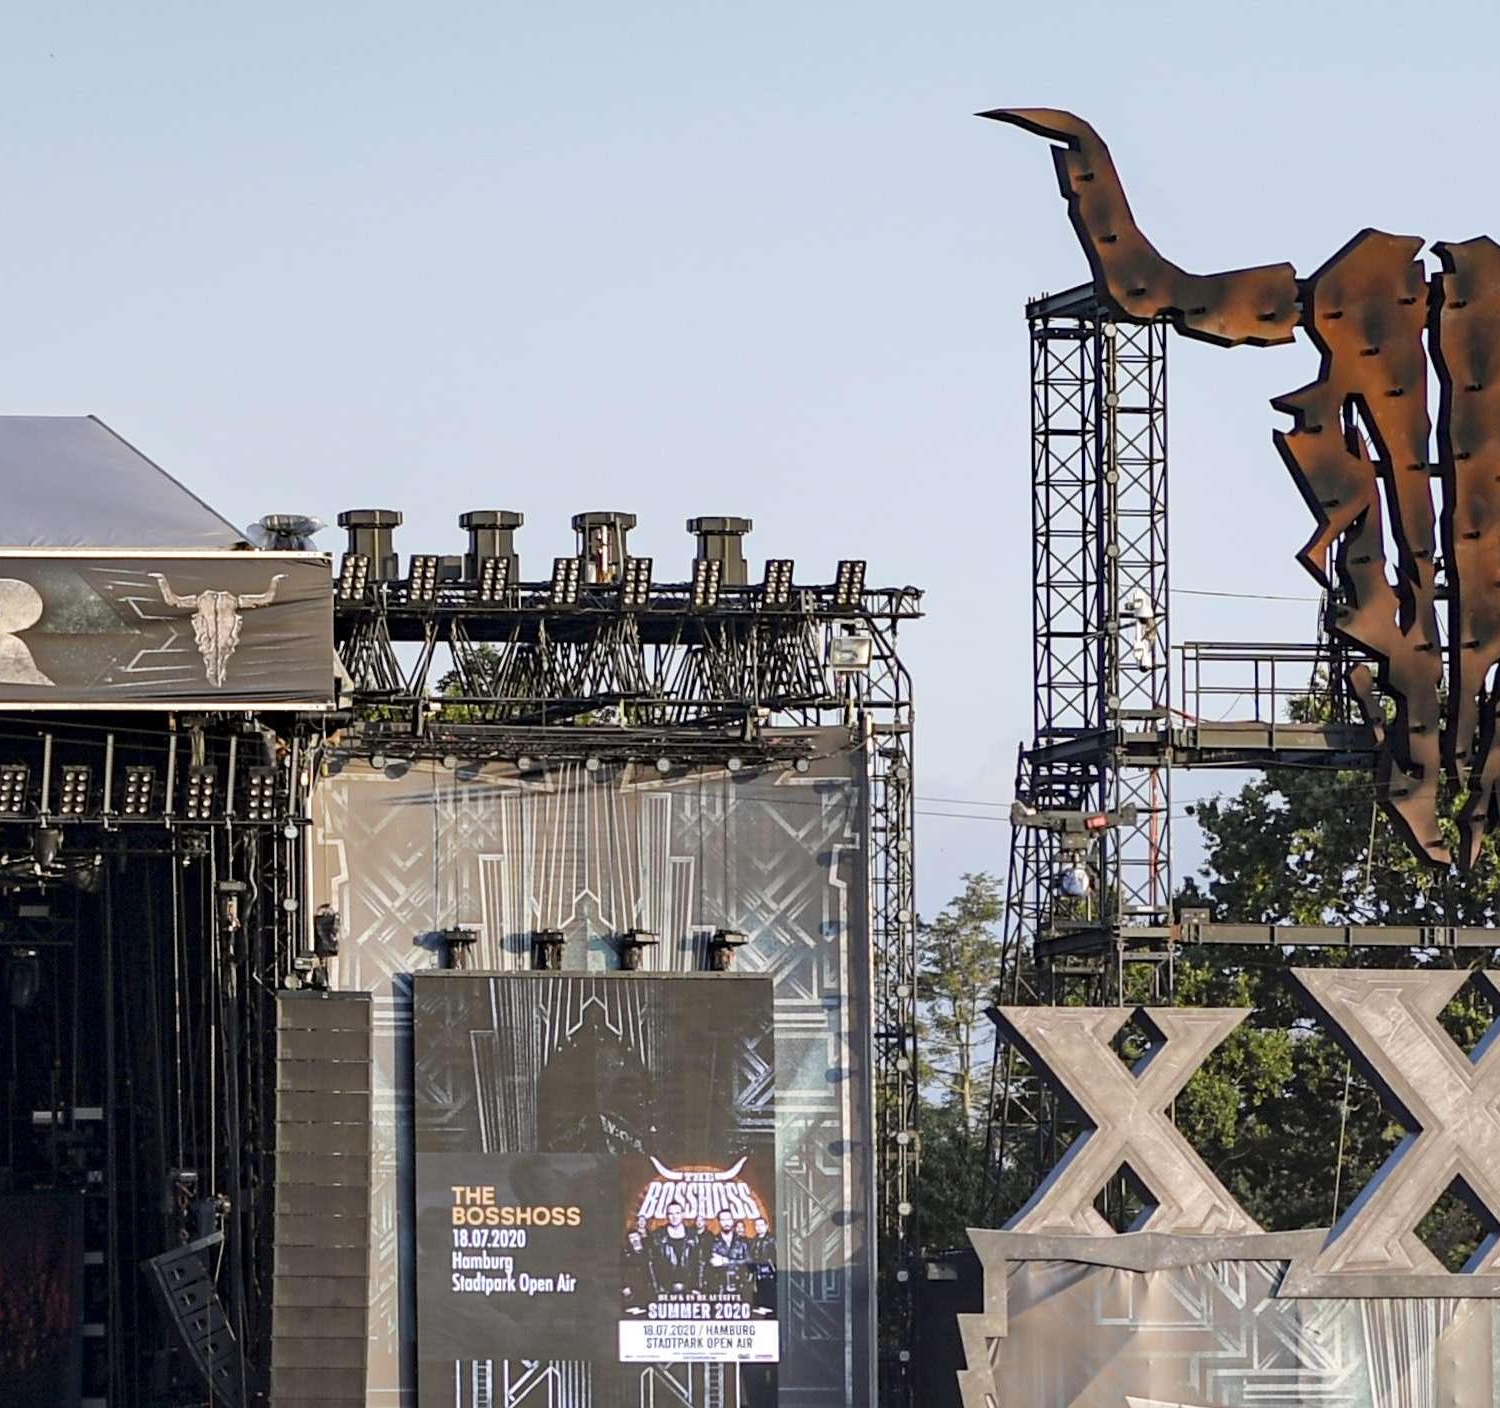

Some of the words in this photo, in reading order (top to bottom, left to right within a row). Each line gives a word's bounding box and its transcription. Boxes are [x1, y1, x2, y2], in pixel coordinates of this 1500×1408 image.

[452, 1186, 495, 1204] THE
[452, 1207, 581, 1225] BOSSHOSS
[453, 1229, 526, 1247] 18.07.2020
[452, 1250, 513, 1273] Hamburg
[452, 1272, 515, 1296] Stadtpark
[519, 1273, 553, 1296] Open
[557, 1273, 576, 1291] Air
[648, 1303, 710, 1318] SUMMER
[715, 1303, 750, 1318] 2020
[644, 1325, 696, 1335] 18.07.2020
[706, 1325, 755, 1335] HAMBURG
[646, 1338, 703, 1348] STADTPARK
[707, 1338, 733, 1348] OPEN
[737, 1338, 753, 1348] AIR
